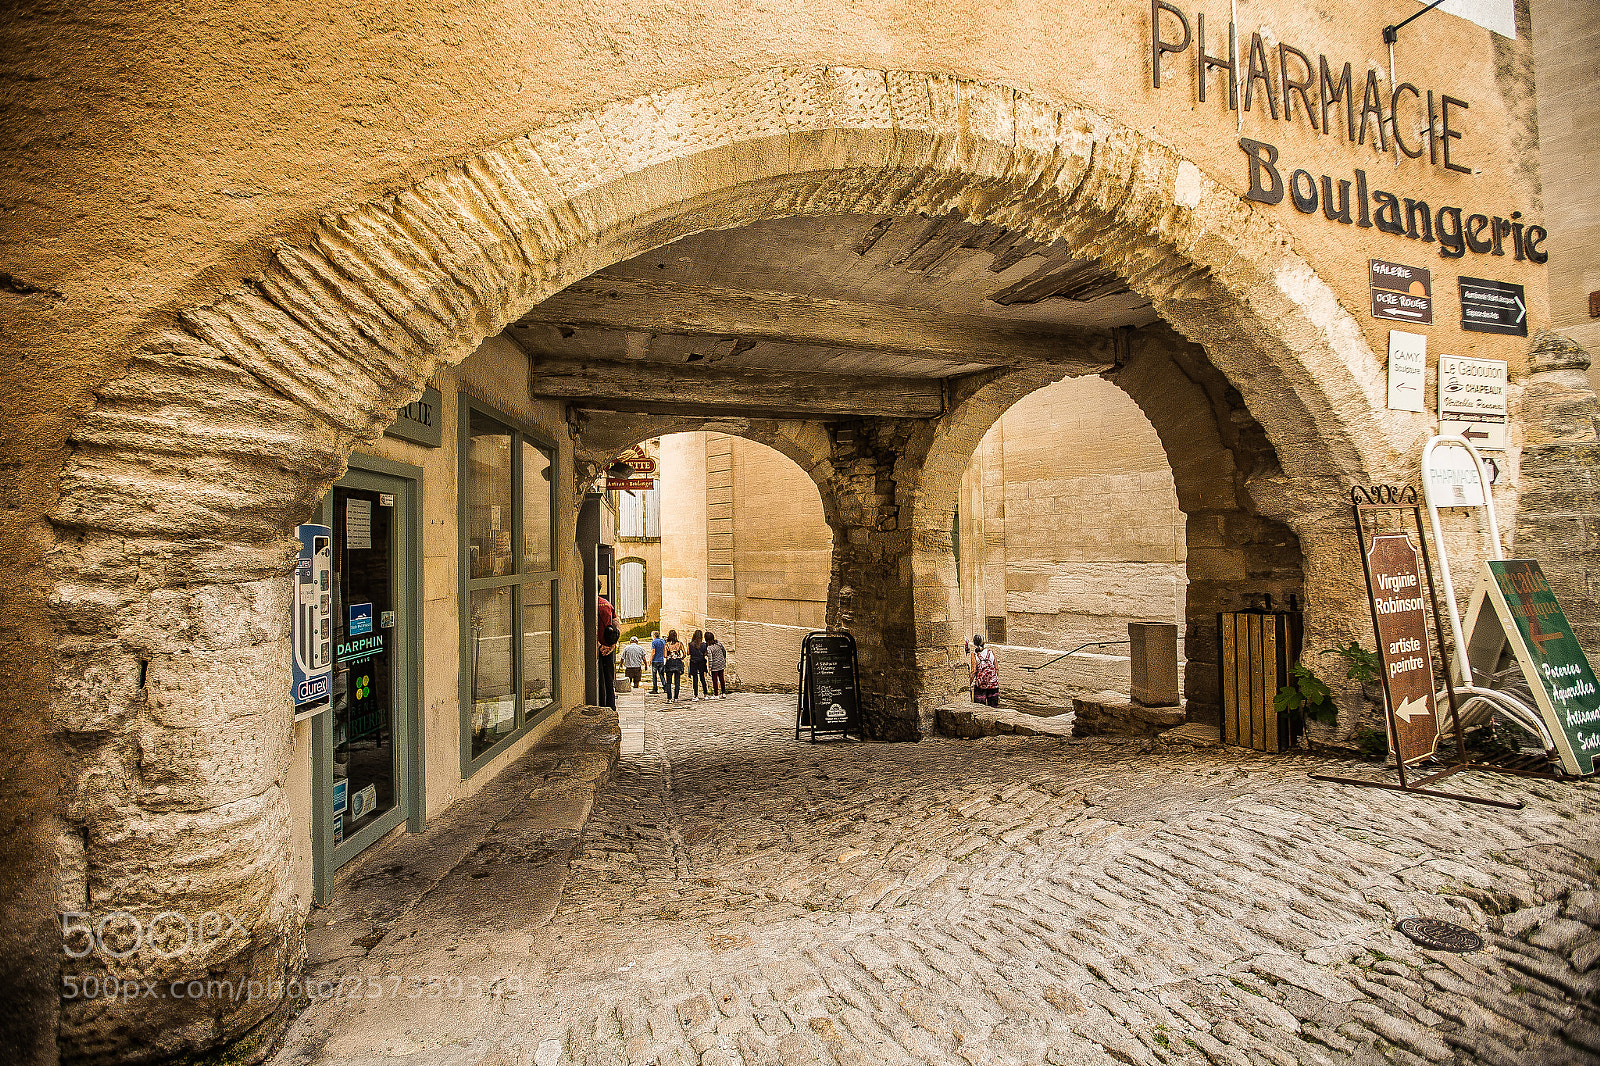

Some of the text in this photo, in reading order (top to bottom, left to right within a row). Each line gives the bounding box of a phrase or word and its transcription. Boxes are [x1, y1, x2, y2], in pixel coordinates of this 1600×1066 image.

[1152, 0, 1471, 174] PHARMACIE
[1239, 137, 1548, 264] Boulangerie
[1373, 263, 1412, 278] GALERIE
[1377, 294, 1428, 309] OCRE ROUGE
[1444, 360, 1455, 374] Le
[1466, 384, 1503, 395] CHAPEAUX
[1430, 468, 1478, 484] PHARMACIE
[1377, 572, 1417, 592] Virginie
[1496, 563, 1548, 595] arcade
[1375, 597, 1424, 615] Robinson
[1508, 600, 1561, 620] boutique
[337, 635, 383, 656] DARPHIN
[1390, 636, 1421, 654] artiste
[1390, 657, 1424, 678] peintre
[1542, 662, 1581, 680] Poteries
[300, 681, 327, 697] durex
[1553, 680, 1595, 705] Aquarelles
